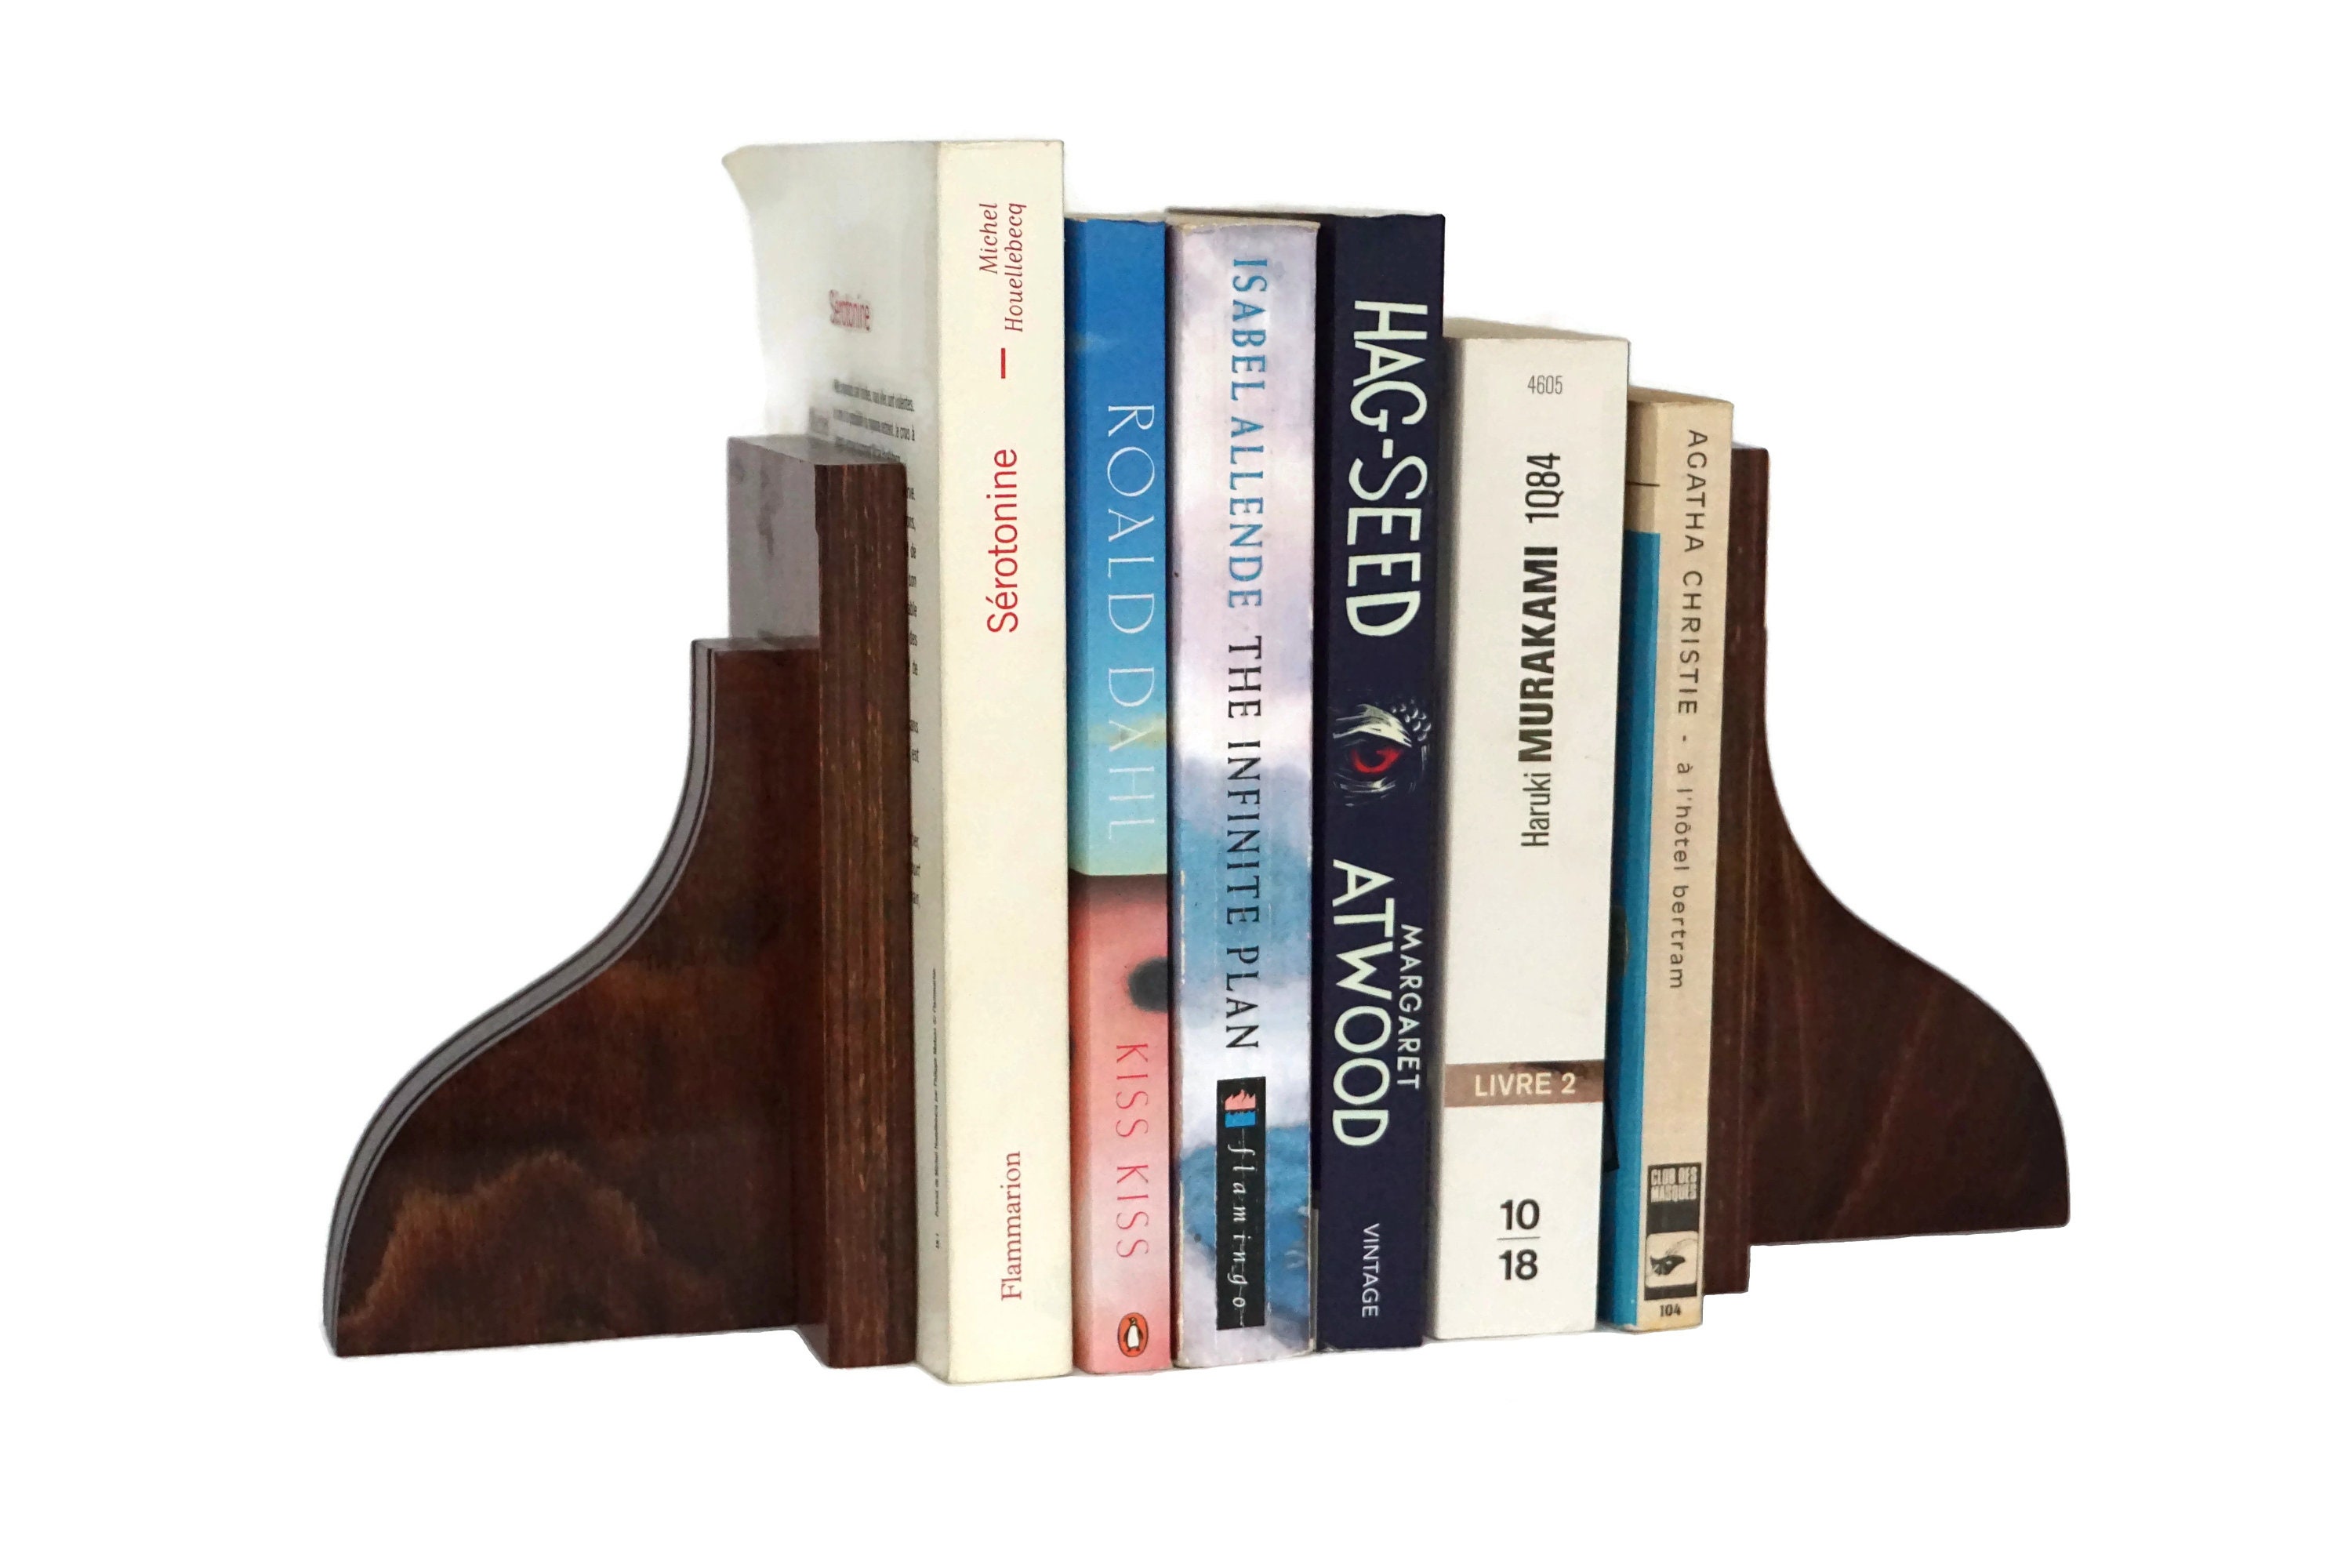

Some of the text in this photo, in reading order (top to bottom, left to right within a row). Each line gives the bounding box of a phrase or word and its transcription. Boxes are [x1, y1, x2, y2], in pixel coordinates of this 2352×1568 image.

[979, 204, 997, 274] Michel
[1004, 204, 1026, 332] Houellebecq
[1528, 376, 1563, 394] 4605
[1346, 301, 1428, 636] HAG-SEED
[1685, 430, 1708, 552] AGATHA
[985, 449, 1018, 632] Sérotonine
[1107, 405, 1155, 840] ROALD DAHL
[1225, 257, 1269, 1049] ISABEL ALLENDE THE INFINITE PLAN
[1519, 453, 1565, 846] Haruki MURAKAMI 1Q84
[1679, 571, 1702, 713] CHRISTIE
[1674, 789, 1693, 869] l'hôtel
[1677, 763, 1693, 774] à
[1670, 885, 1689, 988] bertram
[1333, 859, 1395, 1146] ATWOOD
[1397, 924, 1422, 1089] MARGARET
[1475, 1072, 1577, 1098] LIVRE 2
[1116, 1044, 1149, 1258] KISS KISS
[1650, 1167, 1676, 1186] CLUB
[1000, 1152, 1022, 1300] Flammarion
[1228, 1145, 1255, 1307] flamingo
[1362, 1224, 1379, 1317] VINTAGE
[1500, 1250, 1537, 1280] 18
[1501, 1200, 1539, 1230] 10
[1661, 1305, 1681, 1316] 104
